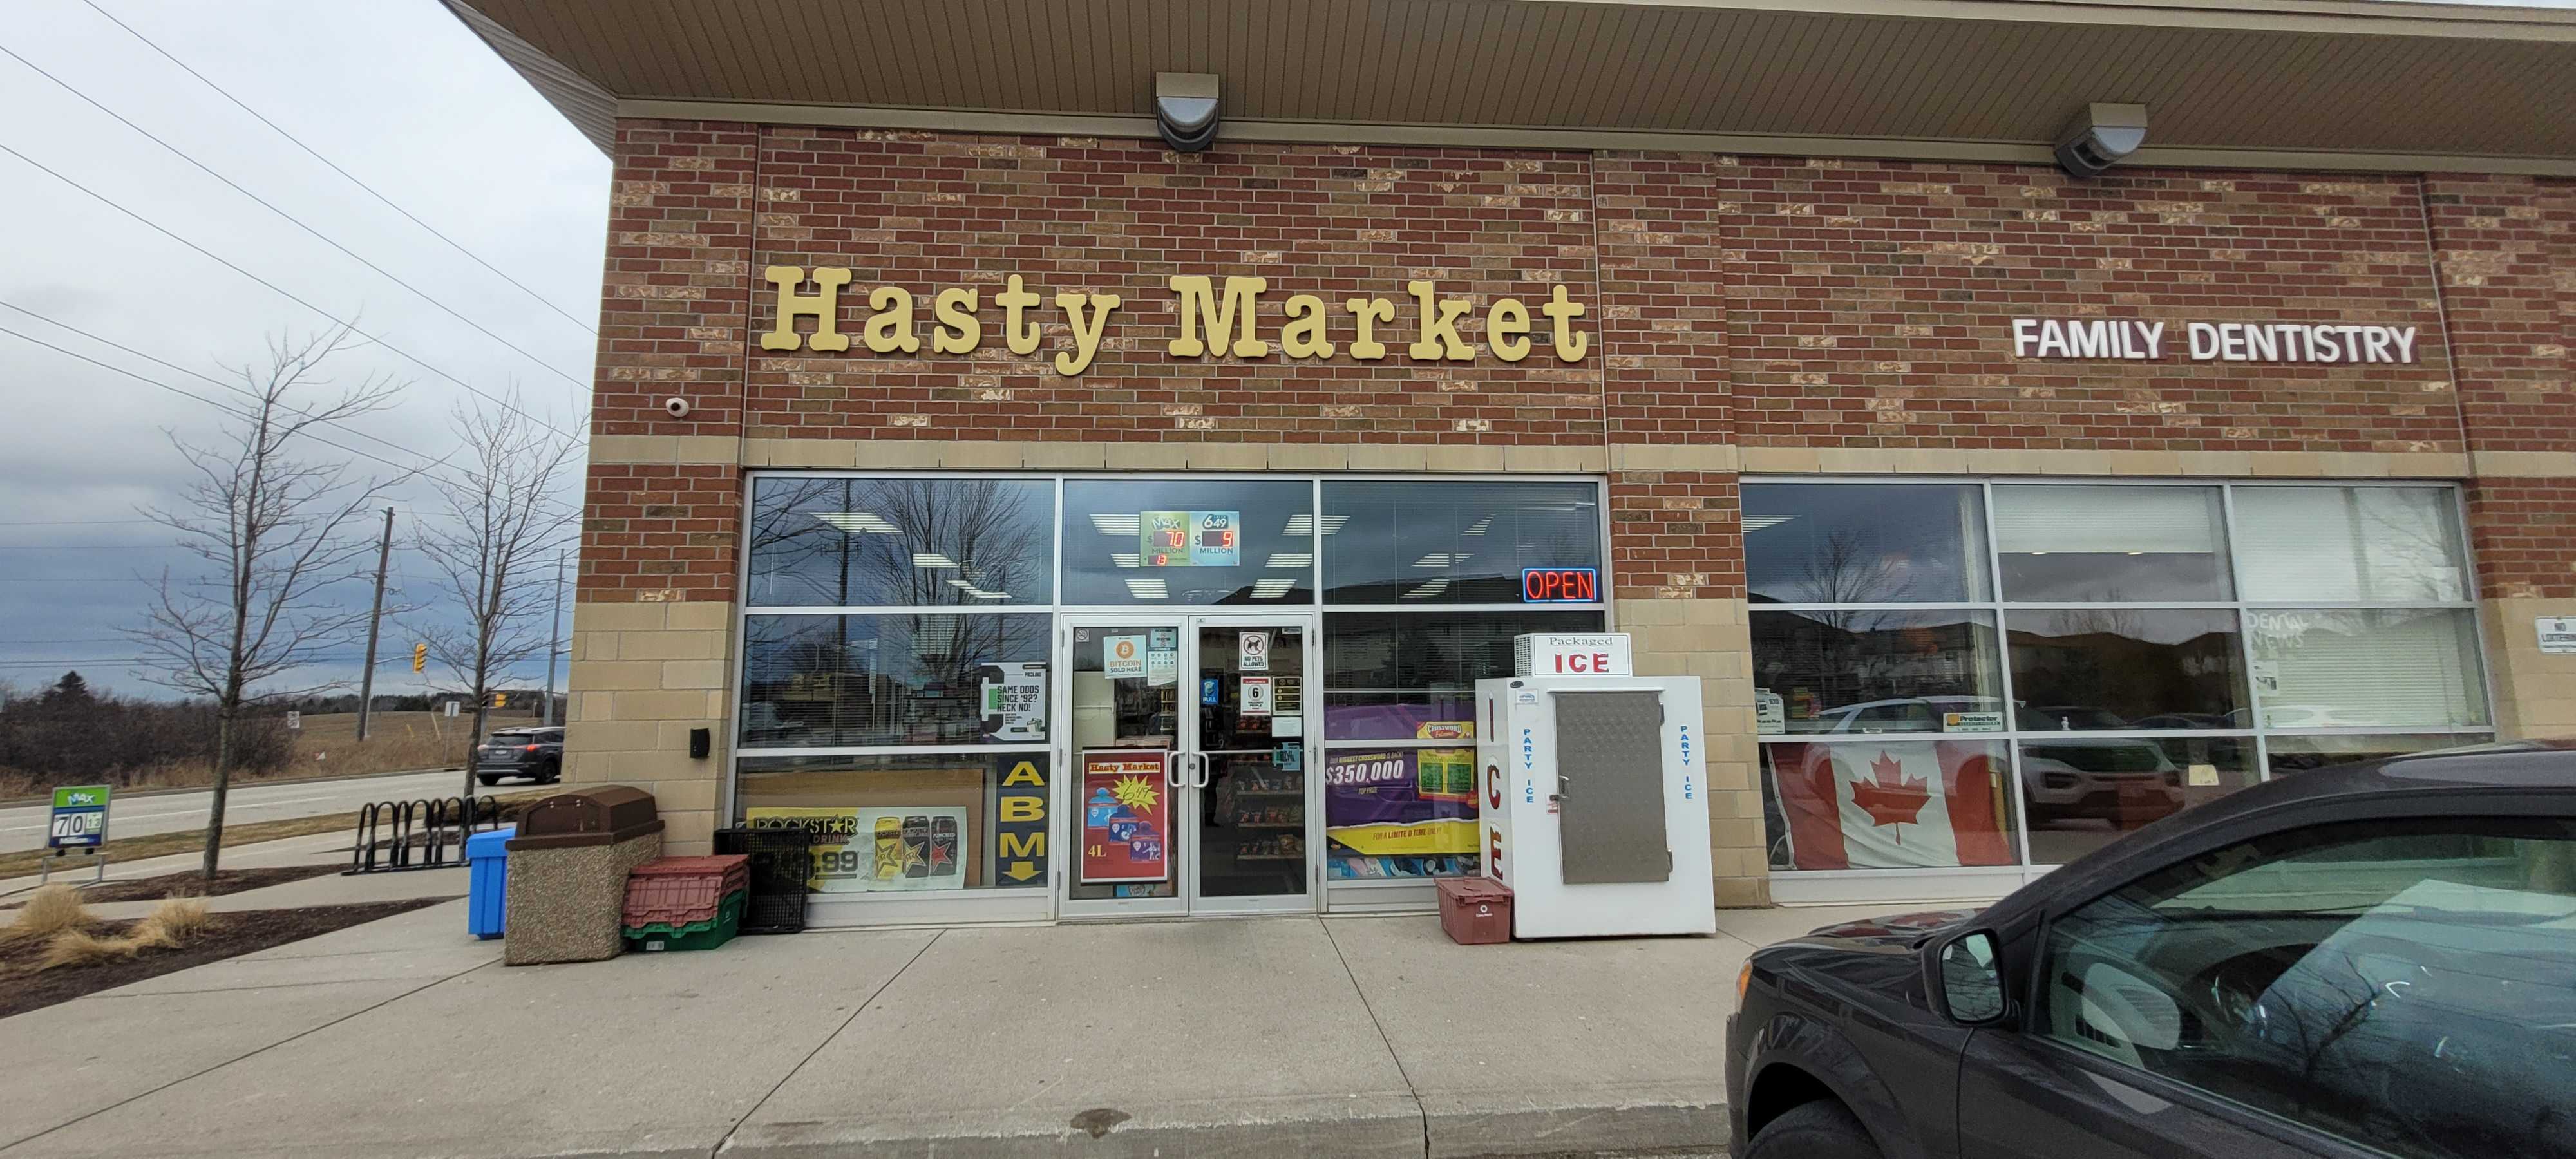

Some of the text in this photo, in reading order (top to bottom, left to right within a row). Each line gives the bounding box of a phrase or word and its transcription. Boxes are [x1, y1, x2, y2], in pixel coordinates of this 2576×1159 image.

[760, 265, 1588, 377] Hasty Market
[2012, 319, 2416, 364] FAMILY DENTISTRY
[1152, 516, 1180, 529] MAX
[1166, 531, 1185, 547] 70
[1195, 531, 1233, 547] $ 9
[1526, 571, 1593, 599] OPEN
[2246, 612, 2309, 630] DENTAL
[1549, 637, 1613, 646] Packaged
[1109, 659, 1142, 668] BITCOIN
[1554, 652, 1609, 674] ICE
[997, 685, 1039, 694] SAME ODDS
[1252, 687, 1260, 698] 6
[997, 703, 1032, 712] HECK NO!
[1427, 724, 1463, 733] CROSSWORD
[1524, 728, 1532, 769] PARTY
[1680, 725, 1690, 766] PARTY
[1358, 753, 1386, 761] CROSSWORD
[1090, 764, 1119, 772] Hasty
[1325, 759, 1405, 784] $350,000
[1526, 779, 1534, 803] ICE
[1684, 775, 1692, 799] ICE
[999, 761, 1046, 858] ABM
[813, 834, 847, 845] DRINK
[1413, 829, 1426, 837] TIME
[1088, 844, 1108, 858] 4L
